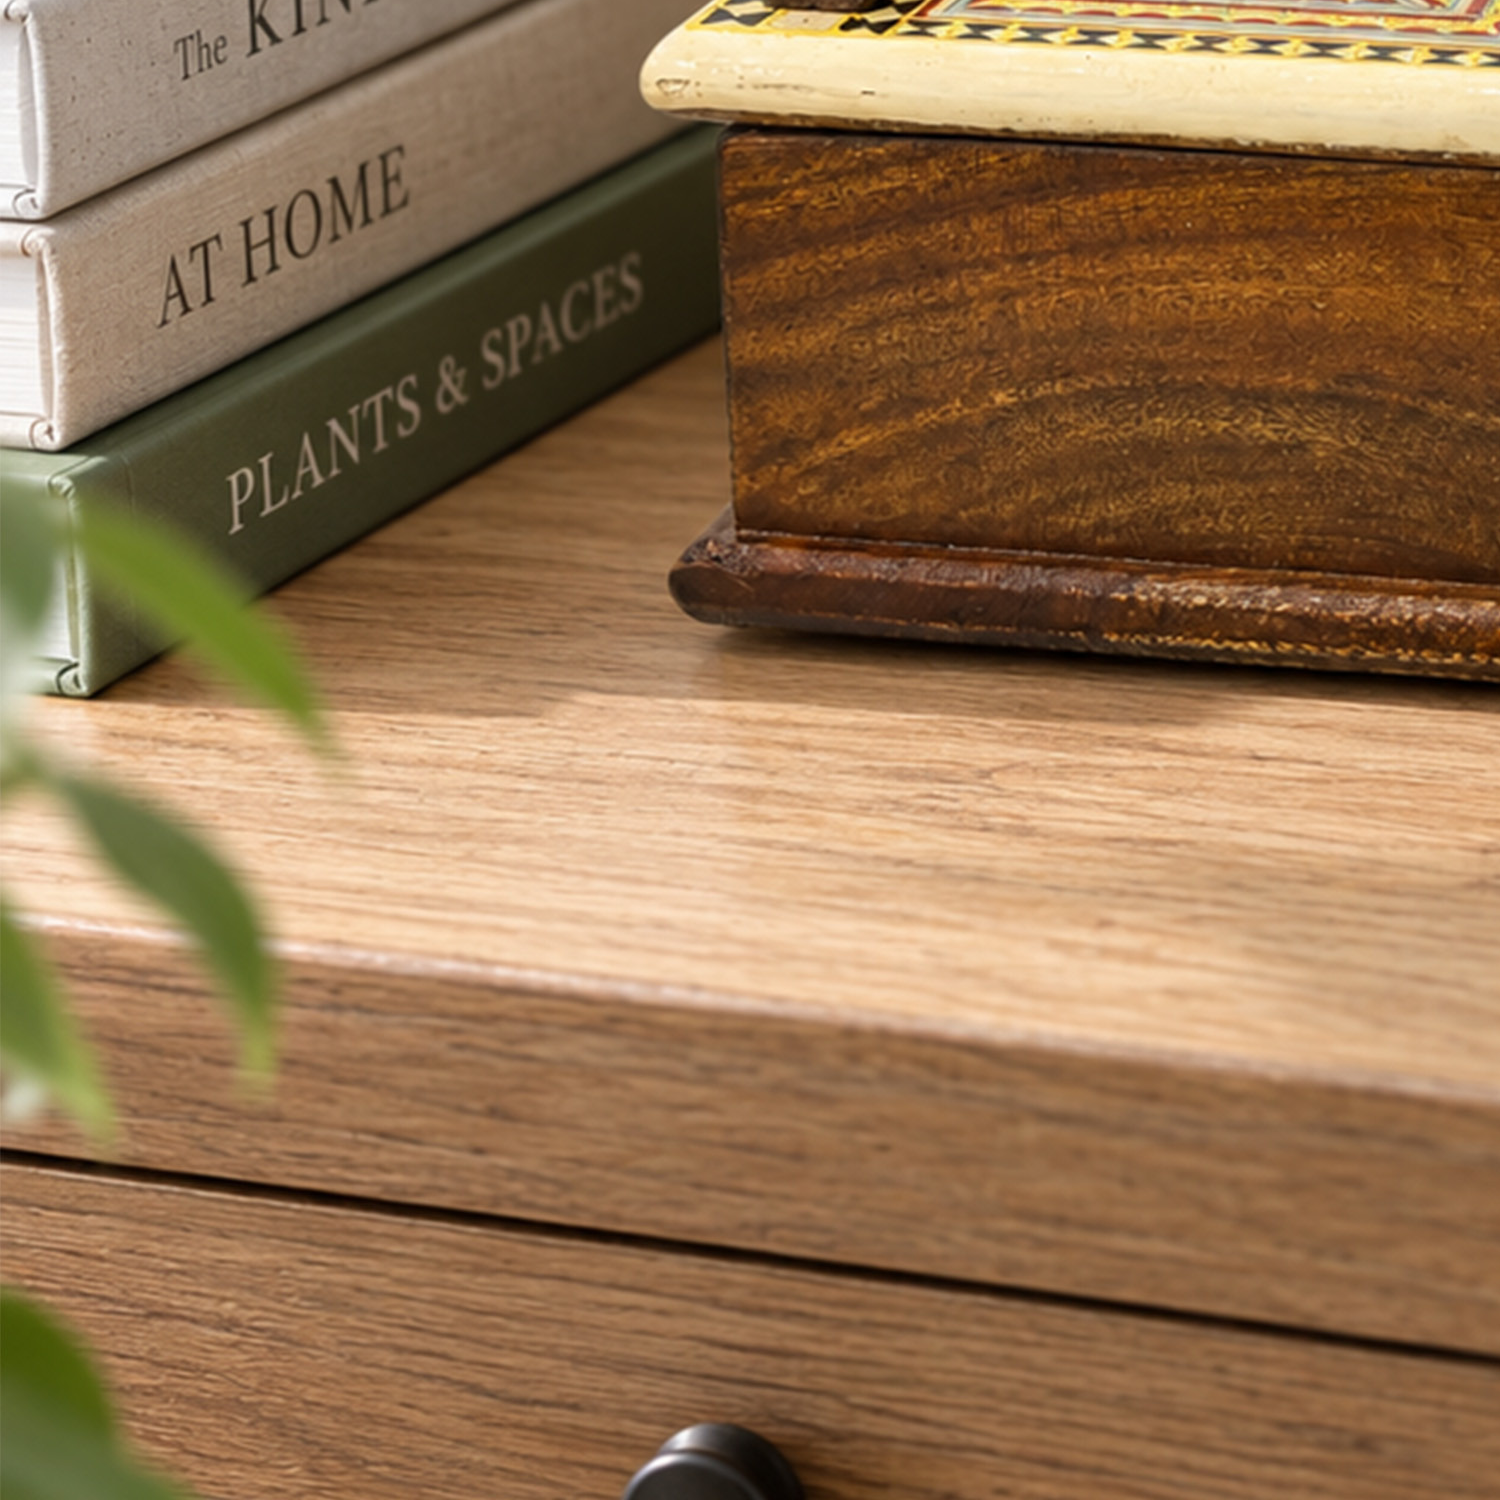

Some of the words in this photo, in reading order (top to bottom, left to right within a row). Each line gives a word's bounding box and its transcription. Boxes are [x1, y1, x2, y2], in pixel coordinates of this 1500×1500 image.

[173, 29, 228, 81] The
[156, 233, 223, 329] AT
[239, 144, 411, 288] HOME
[225, 374, 422, 535] PLANTS
[435, 354, 470, 414] &
[479, 251, 644, 390] SPACES
